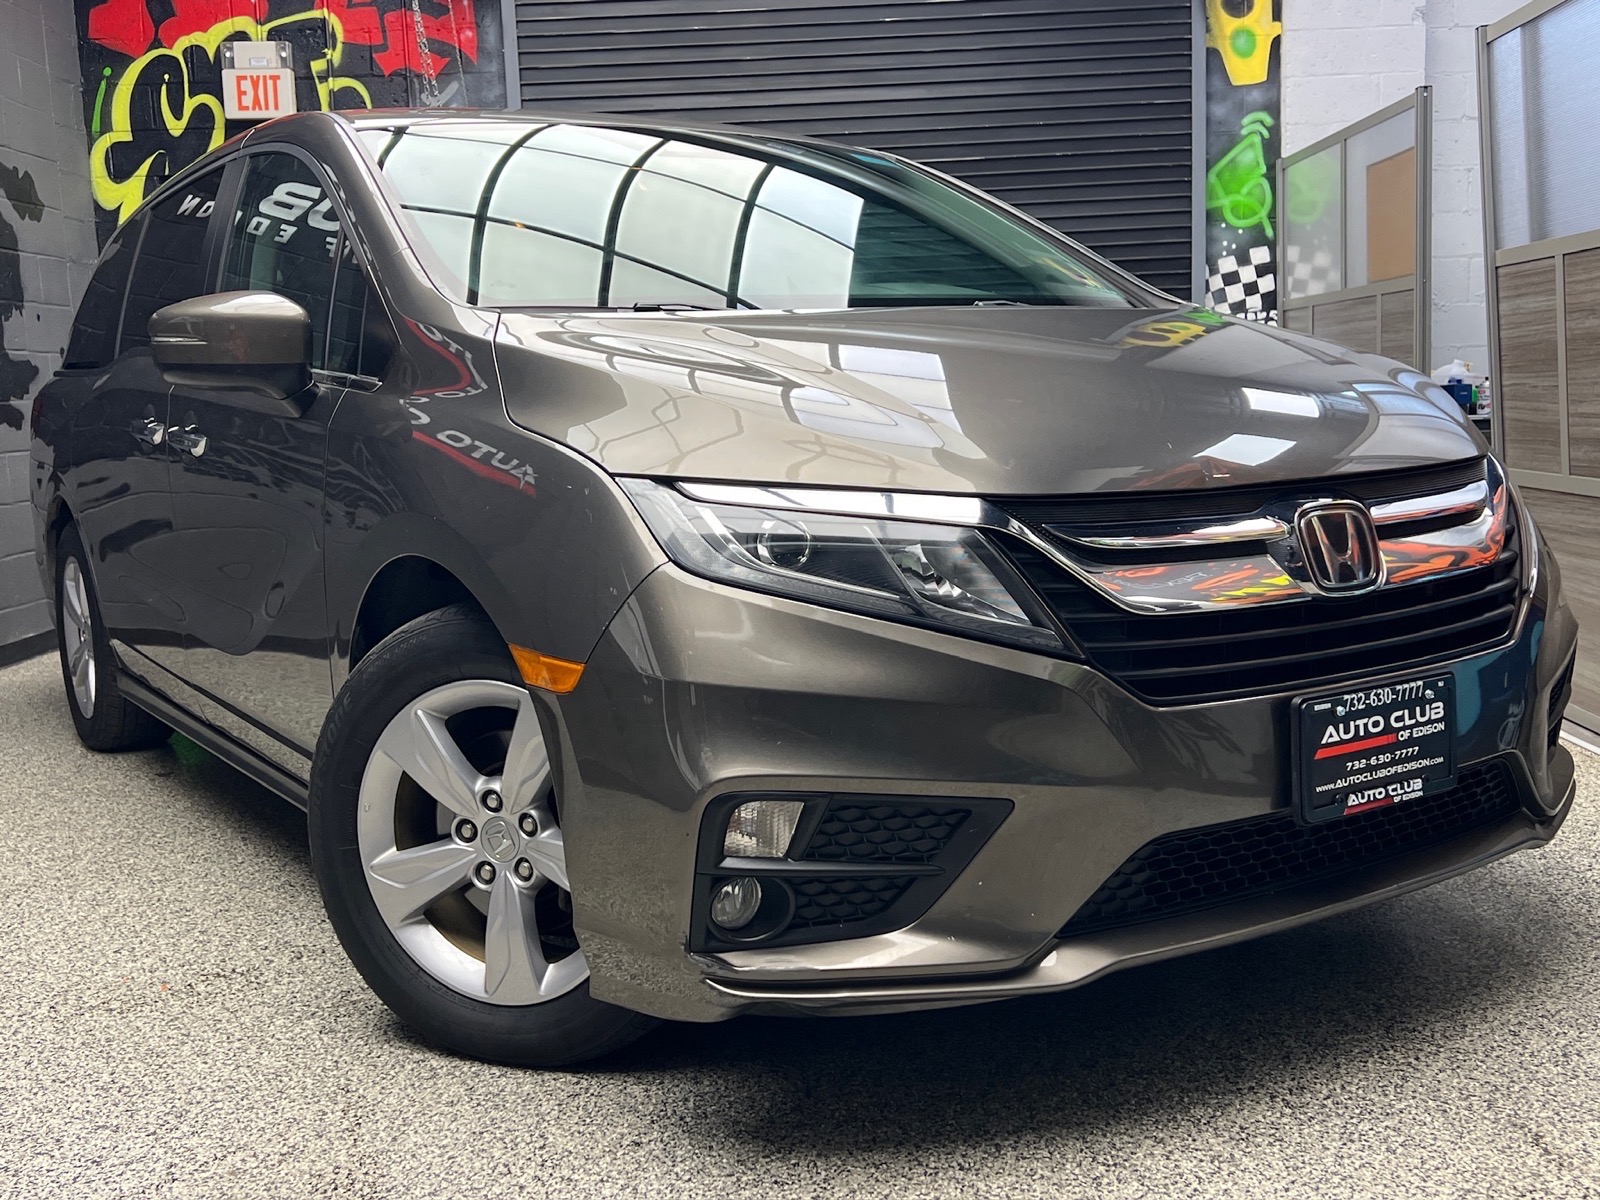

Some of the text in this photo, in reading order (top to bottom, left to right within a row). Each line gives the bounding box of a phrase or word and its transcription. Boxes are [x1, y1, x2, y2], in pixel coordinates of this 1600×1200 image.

[236, 75, 281, 112] EXIT
[1343, 681, 1424, 711] 732-630-7777
[1320, 701, 1445, 745] AUTO CLUB
[1398, 721, 1445, 741] OF EDISON
[1345, 746, 1419, 771] 732-630-7777
[1347, 778, 1423, 807] AUTO CLUB
[1393, 790, 1424, 803] OF EDISON
